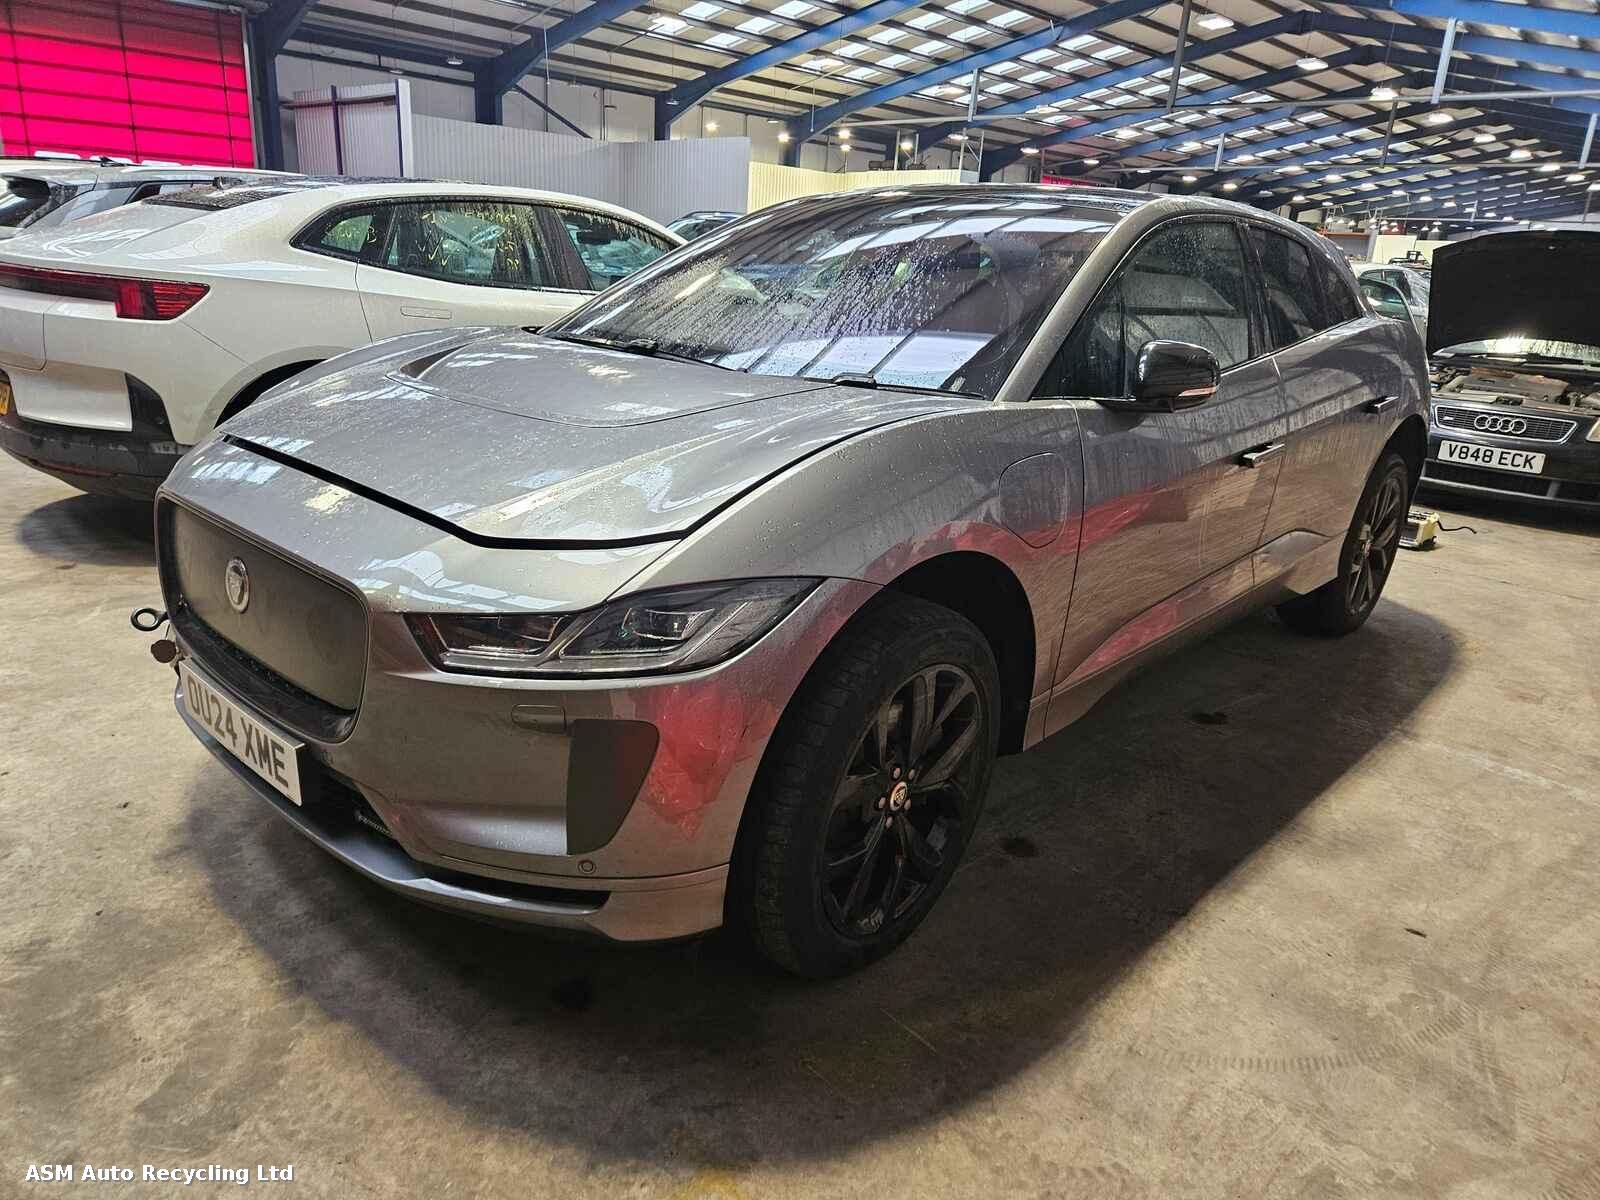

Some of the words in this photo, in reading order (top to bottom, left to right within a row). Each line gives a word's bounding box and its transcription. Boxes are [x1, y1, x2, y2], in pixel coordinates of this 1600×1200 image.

[1448, 444, 1494, 463] V848
[1498, 451, 1537, 470] ECK
[240, 716, 289, 789] XME
